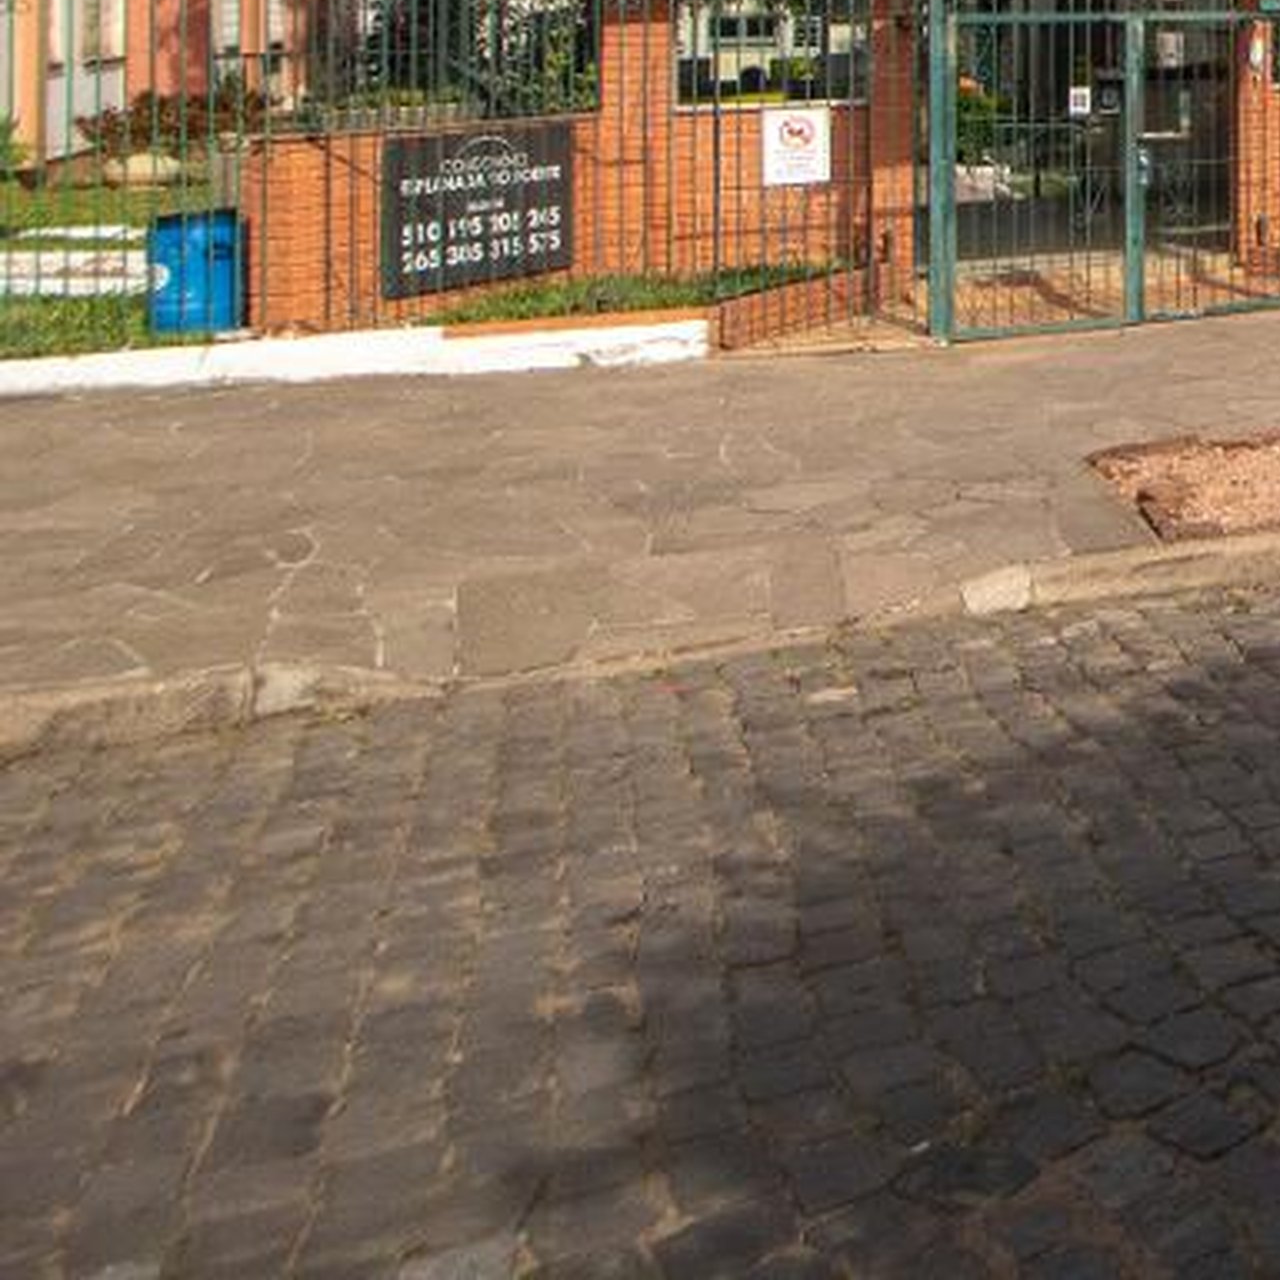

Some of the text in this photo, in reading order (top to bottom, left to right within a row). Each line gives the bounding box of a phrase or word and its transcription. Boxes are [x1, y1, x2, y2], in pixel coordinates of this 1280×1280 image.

[402, 222, 441, 246] 510
[402, 248, 441, 273] 265
[490, 236, 522, 260] 315
